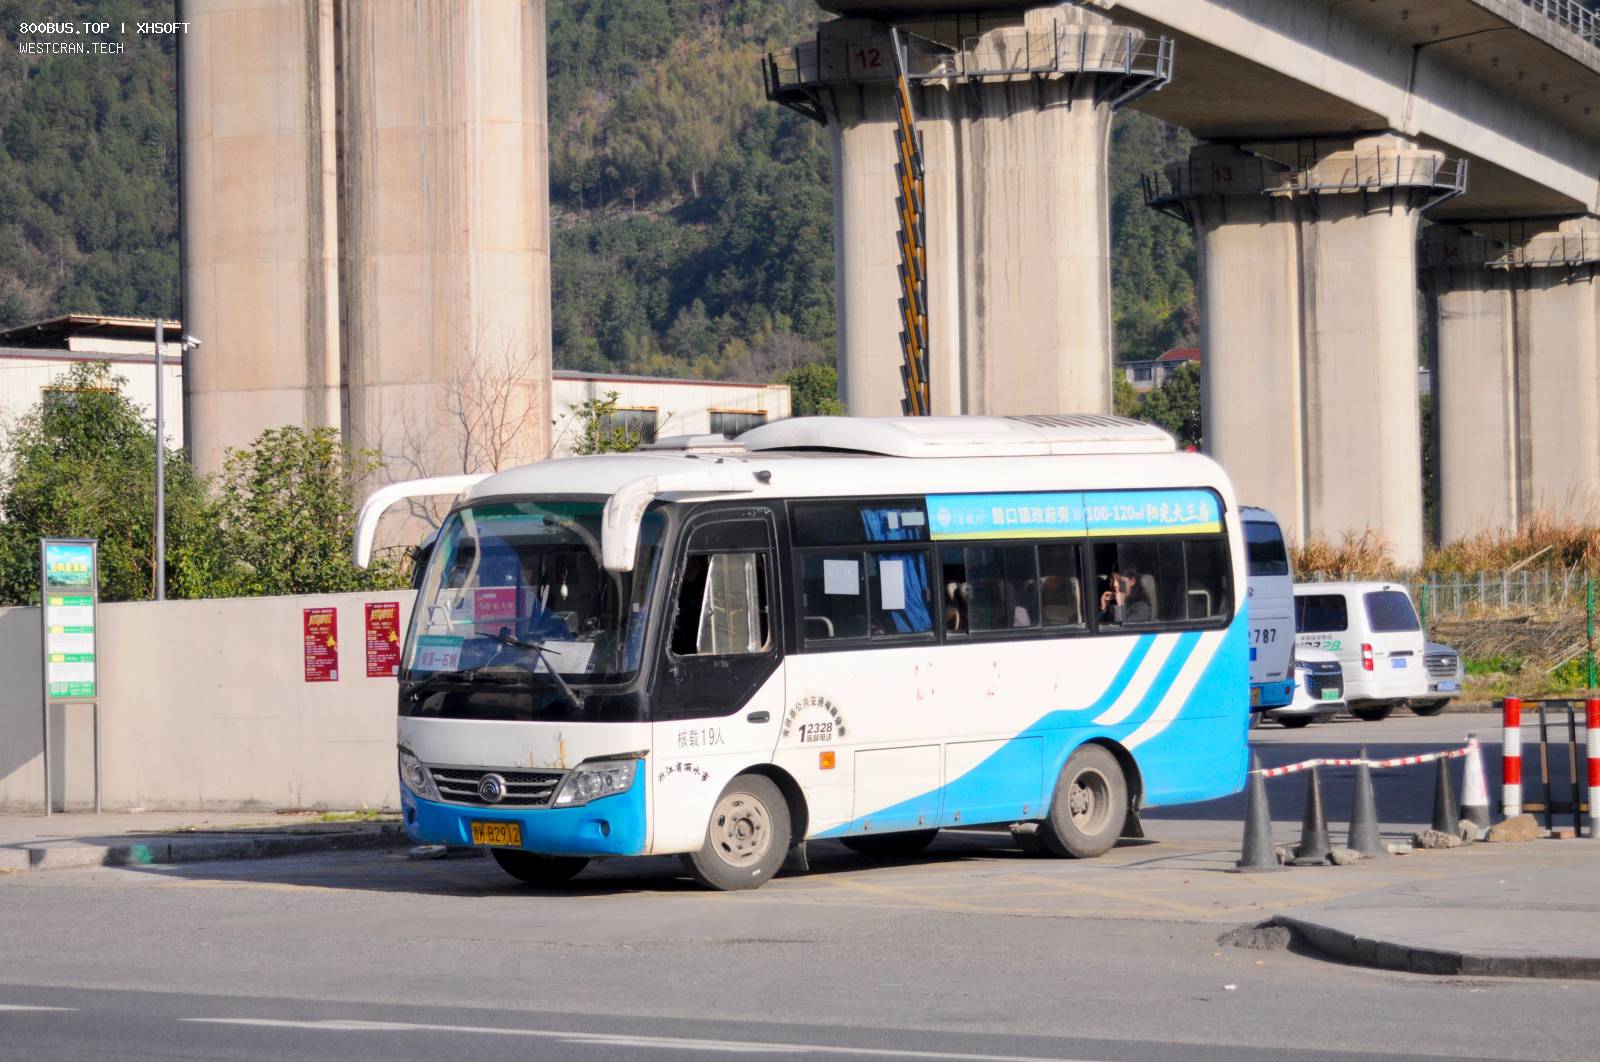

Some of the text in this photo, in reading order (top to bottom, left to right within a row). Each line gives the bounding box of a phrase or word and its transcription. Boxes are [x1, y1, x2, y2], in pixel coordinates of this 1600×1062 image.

[857, 48, 881, 69] 12
[1216, 167, 1232, 183] 13
[678, 726, 725, 748] 核载19人
[799, 722, 833, 743] 12328
